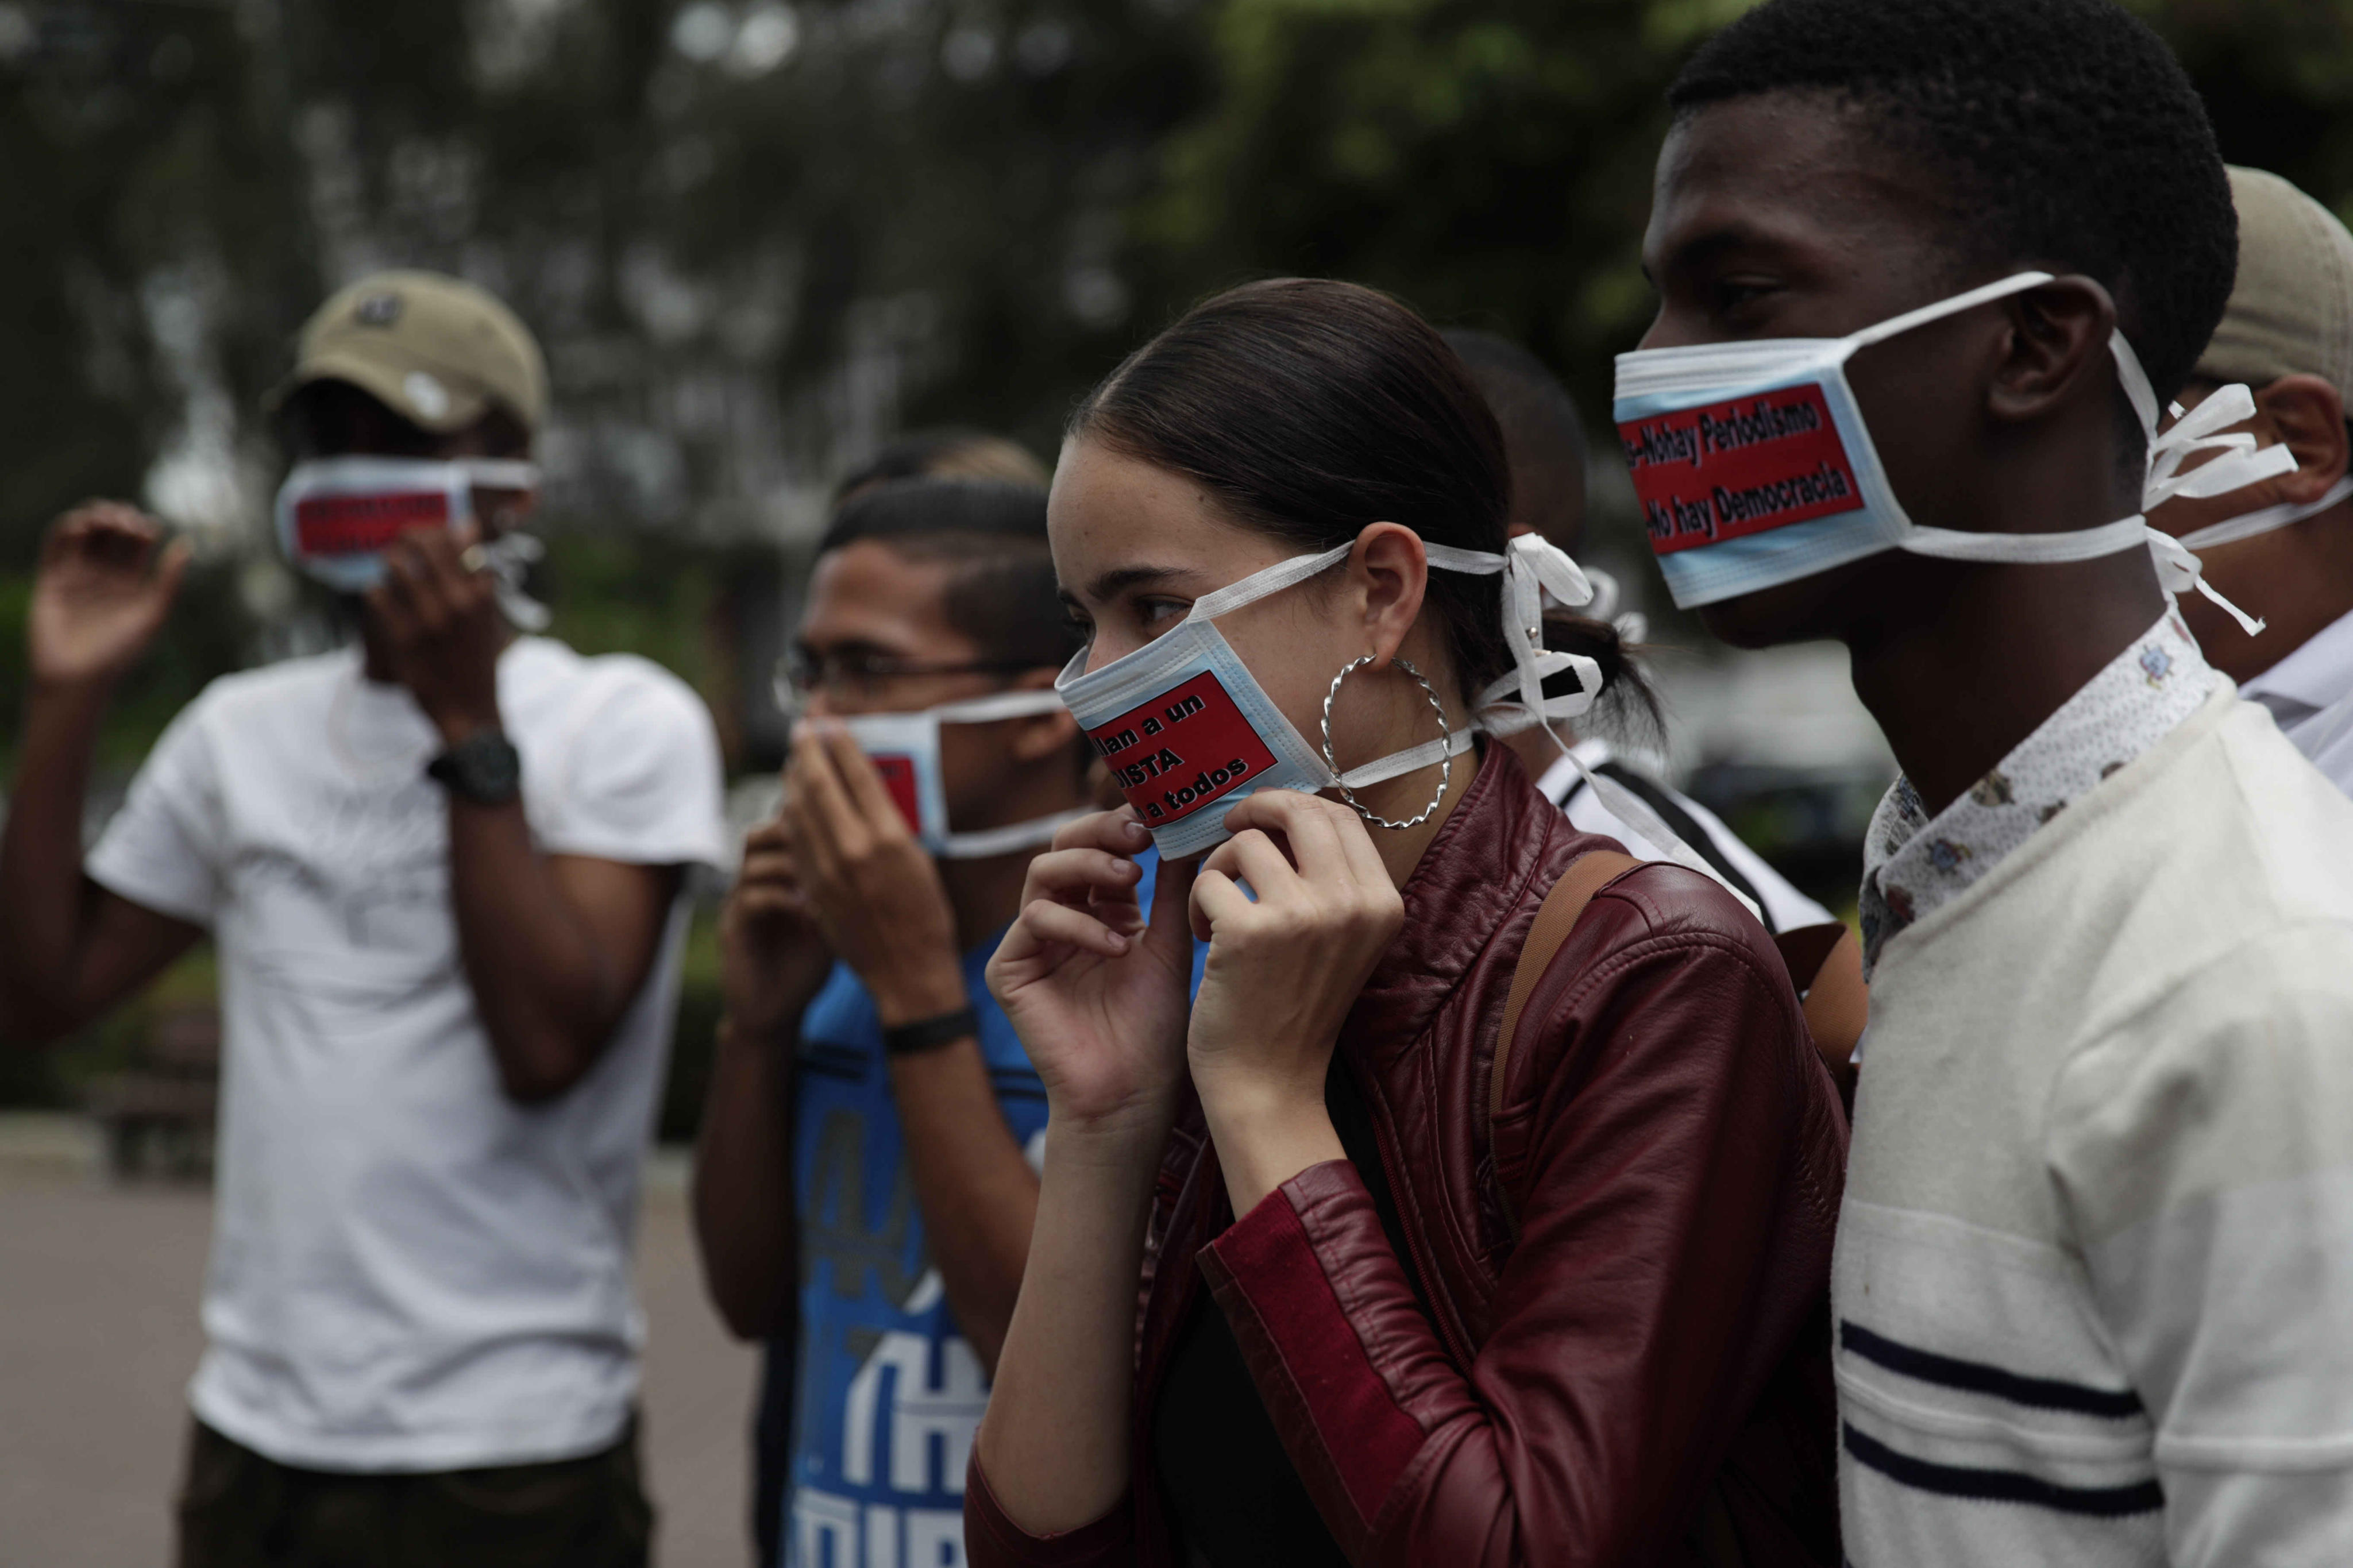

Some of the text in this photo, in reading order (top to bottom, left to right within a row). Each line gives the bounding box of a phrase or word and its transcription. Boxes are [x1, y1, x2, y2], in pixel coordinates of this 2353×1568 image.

[1699, 400, 1820, 453] Periodismo
[1673, 496, 1718, 539] hay
[1712, 462, 1849, 523] Democracia
[1142, 717, 1165, 736] a
[1166, 694, 1206, 723] un
[1147, 802, 1166, 818] a
[1164, 758, 1248, 810] todos
